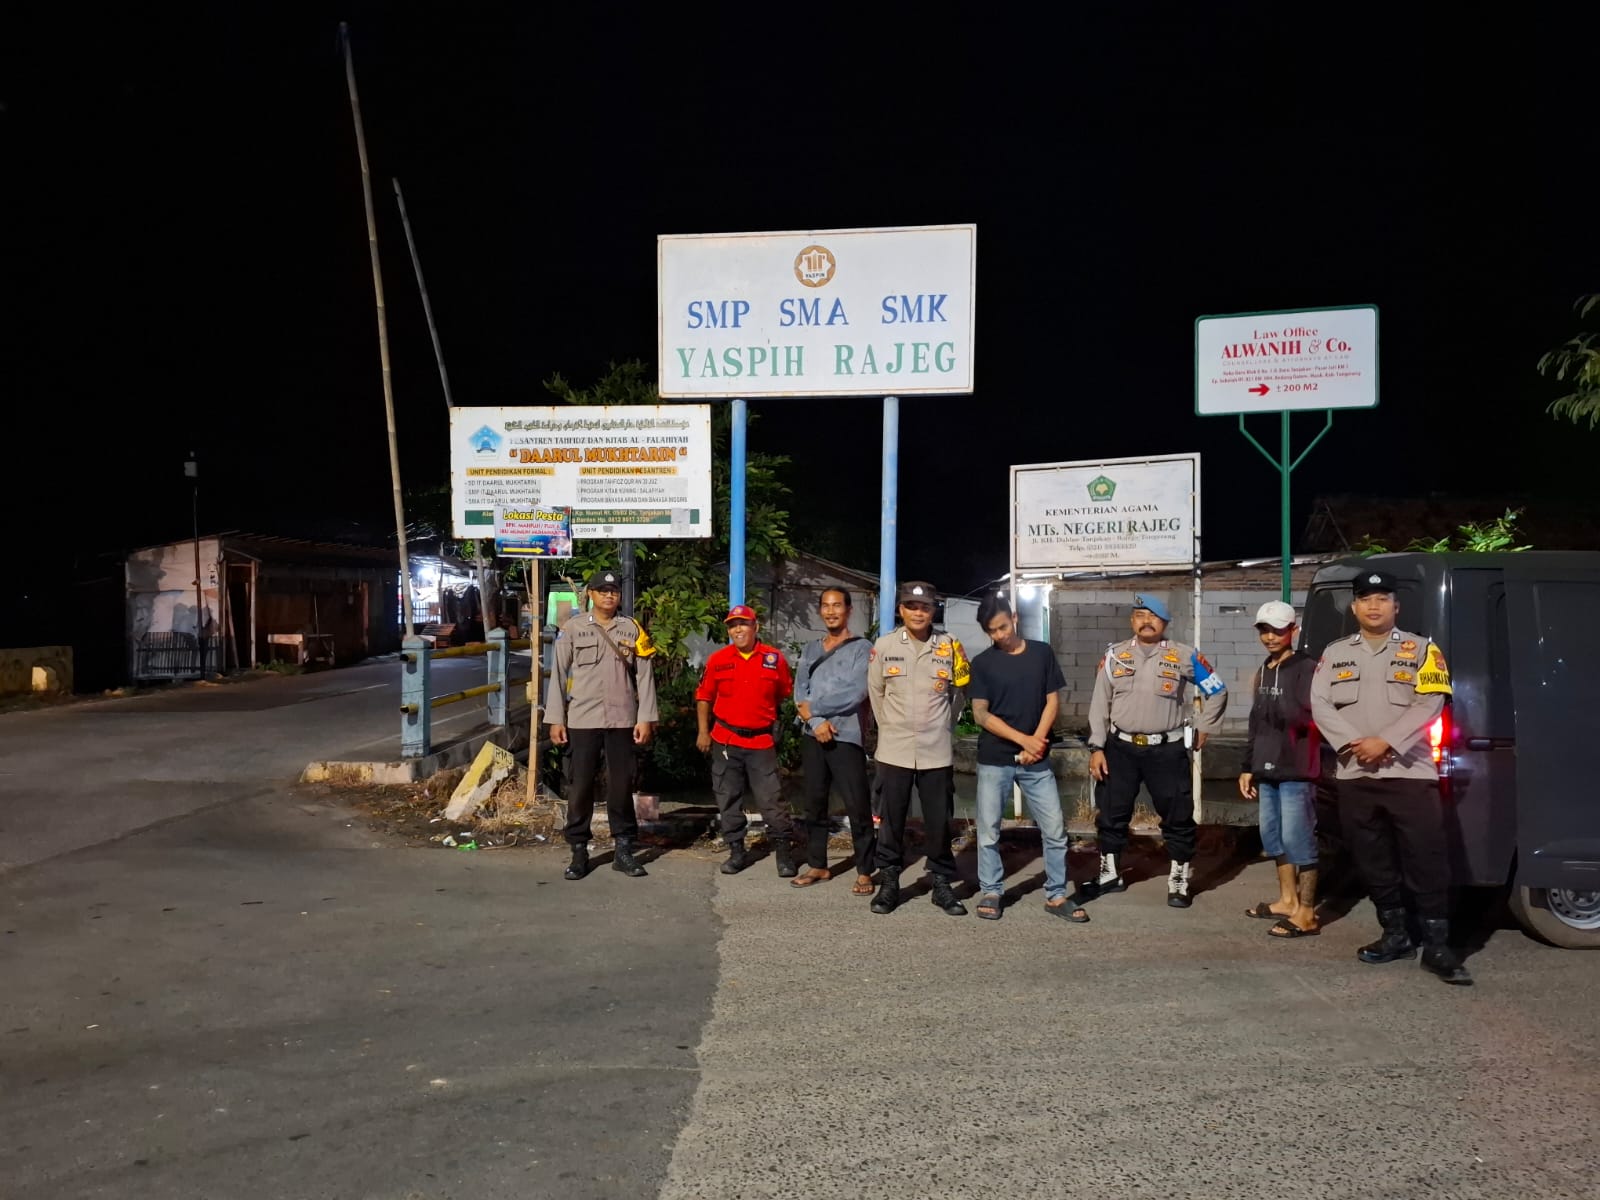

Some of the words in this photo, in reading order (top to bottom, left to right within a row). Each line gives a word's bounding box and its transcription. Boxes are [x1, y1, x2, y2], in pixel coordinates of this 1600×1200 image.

[687, 300, 750, 329] SMP
[779, 297, 849, 326] SMA
[881, 294, 948, 324] SMK
[1253, 329, 1279, 340] Law
[1283, 326, 1318, 337] Office
[1221, 340, 1301, 359] ALWANIH
[1308, 338, 1322, 354] &
[1325, 337, 1352, 353] Co.
[676, 345, 804, 378] YASPIH
[833, 341, 956, 376] RAJEG
[1283, 383, 1301, 392] 200
[1303, 382, 1318, 391] M2
[519, 448, 583, 464] DAARUL
[583, 447, 677, 463] MUKHTARIN
[503, 508, 535, 521] Lokasi
[535, 510, 564, 521] Pesta
[1045, 506, 1118, 517] KEMENTERIAN
[1122, 504, 1159, 513] AGAMA
[1028, 524, 1059, 537] MTs.
[1063, 521, 1123, 535] NEGERI
[1126, 517, 1181, 533] RAJEG
[1159, 661, 1181, 670] POLRI
[1331, 661, 1357, 669] ABDUL
[1390, 660, 1419, 669] POLRI
